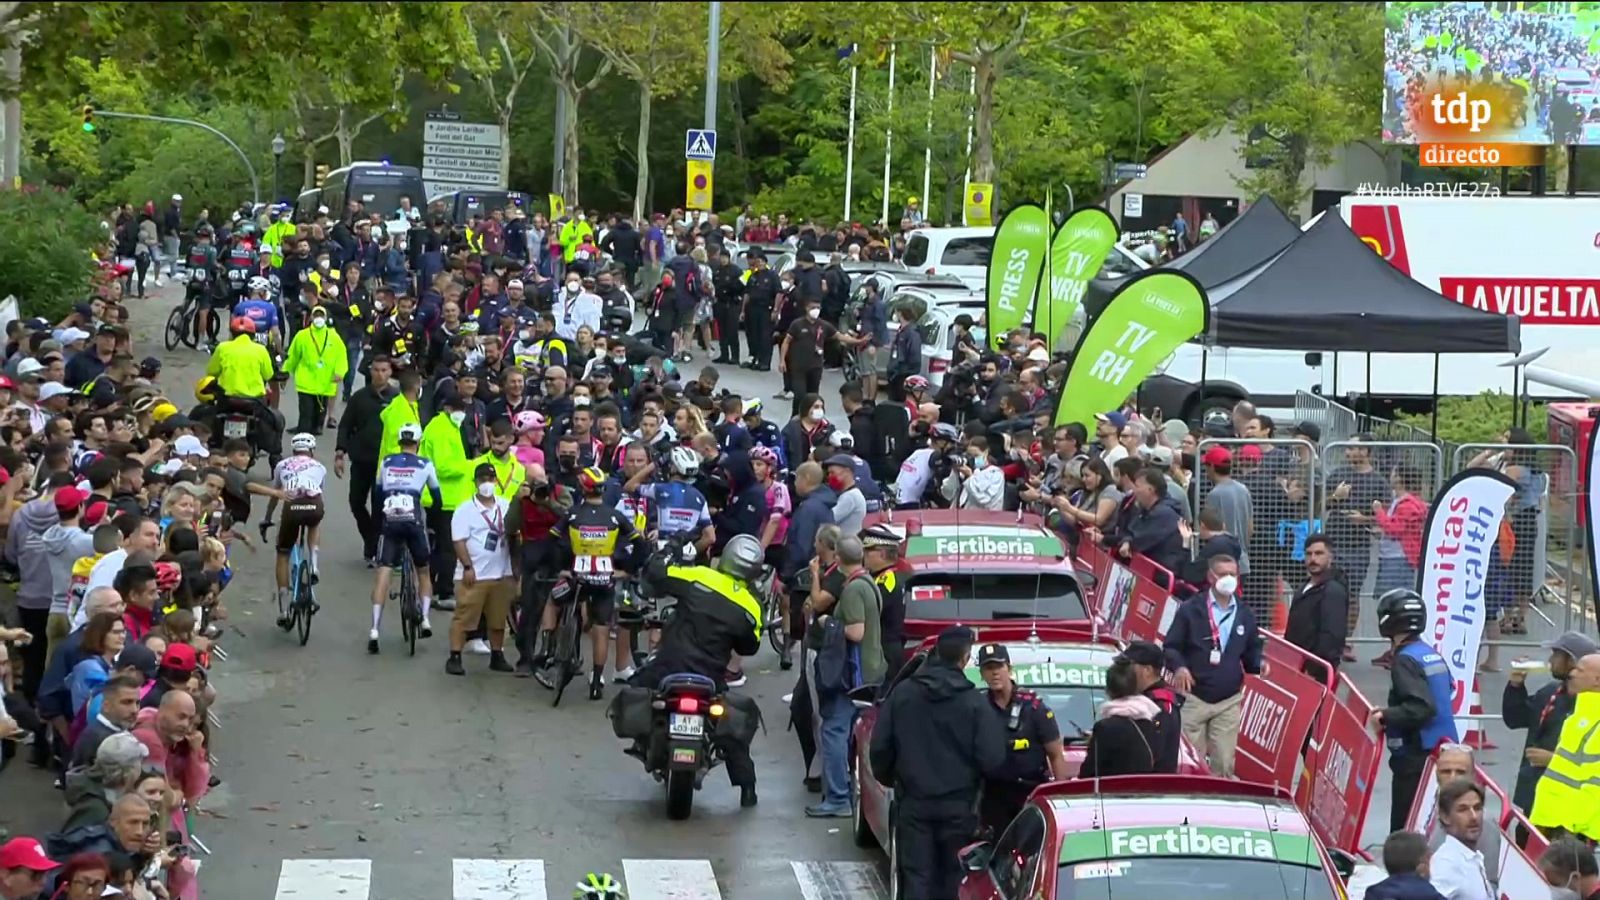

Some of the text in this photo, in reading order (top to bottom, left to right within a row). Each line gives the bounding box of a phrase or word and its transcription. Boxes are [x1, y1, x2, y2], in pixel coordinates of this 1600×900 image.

[998, 248, 1029, 311] PRESS
[1065, 251, 1091, 276] TV
[1051, 276, 1089, 304] NRH
[1494, 285, 1600, 317] VUELTA
[1115, 320, 1157, 354] TV
[1089, 350, 1134, 386] RH
[936, 536, 1034, 555] Fertiberia
[1111, 826, 1275, 858] Fertiberia
